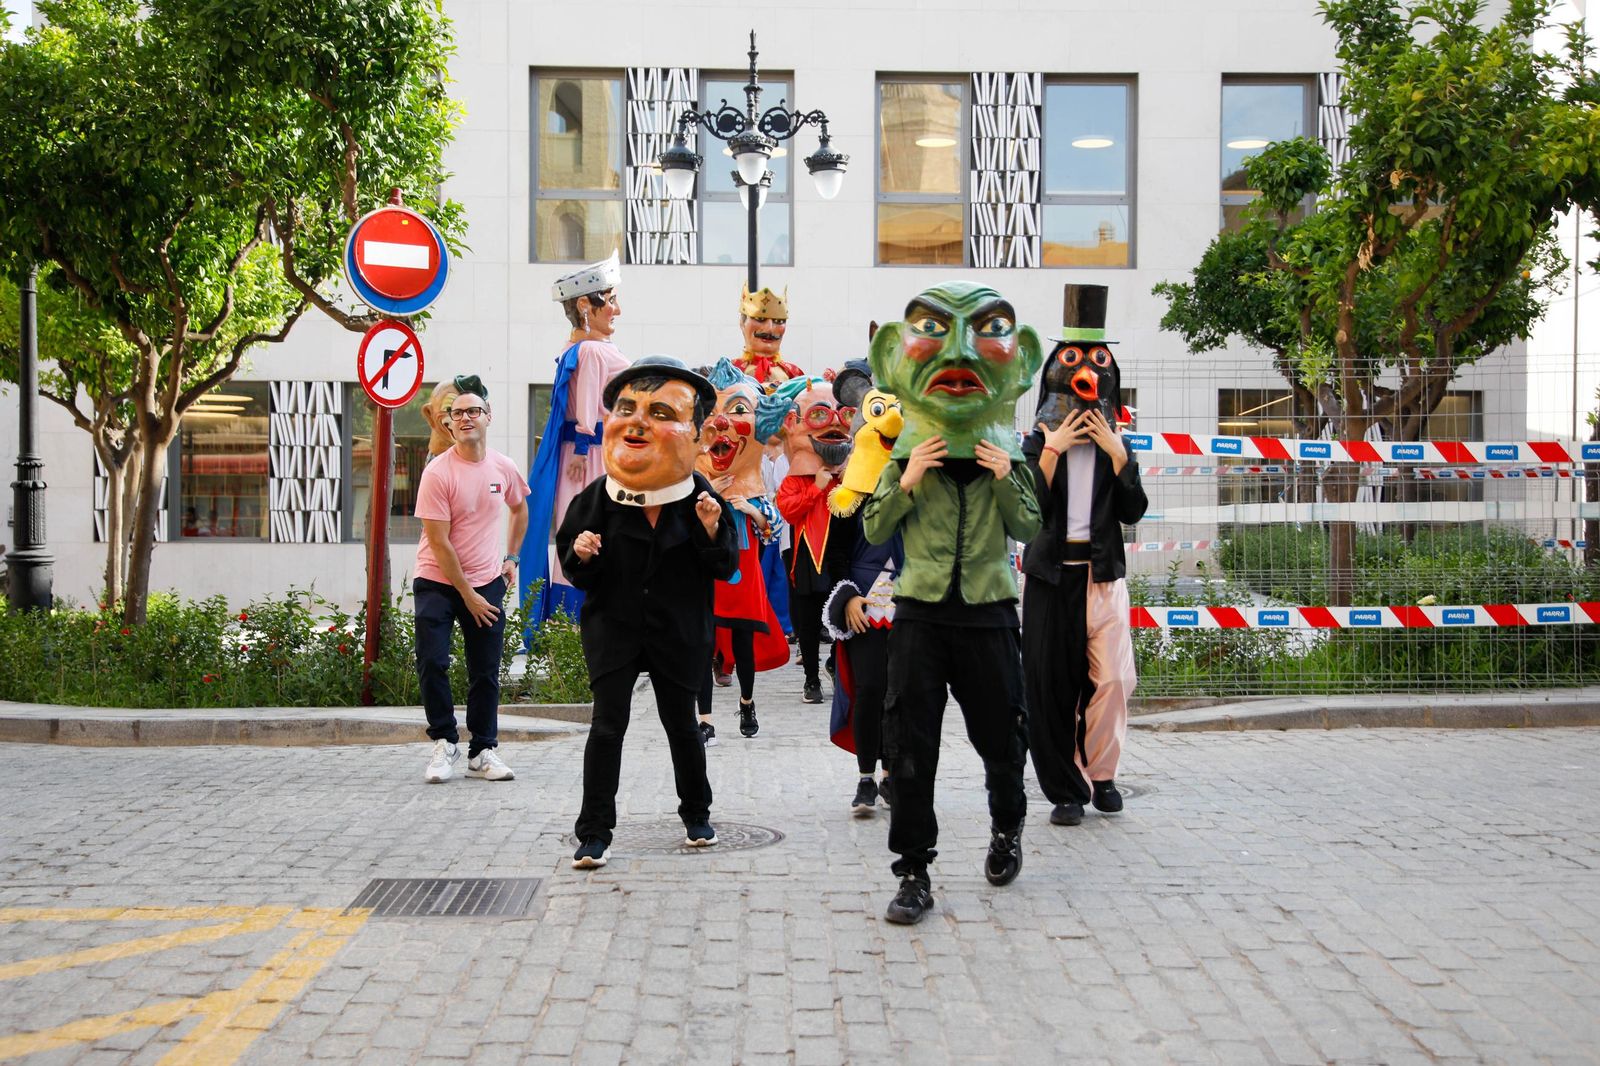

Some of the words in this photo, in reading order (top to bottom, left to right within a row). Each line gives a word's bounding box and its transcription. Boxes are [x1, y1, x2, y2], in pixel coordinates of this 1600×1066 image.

[1130, 438, 1148, 446] ARRA
[1305, 446, 1326, 454] PARRA
[1543, 610, 1565, 618] PARRA
